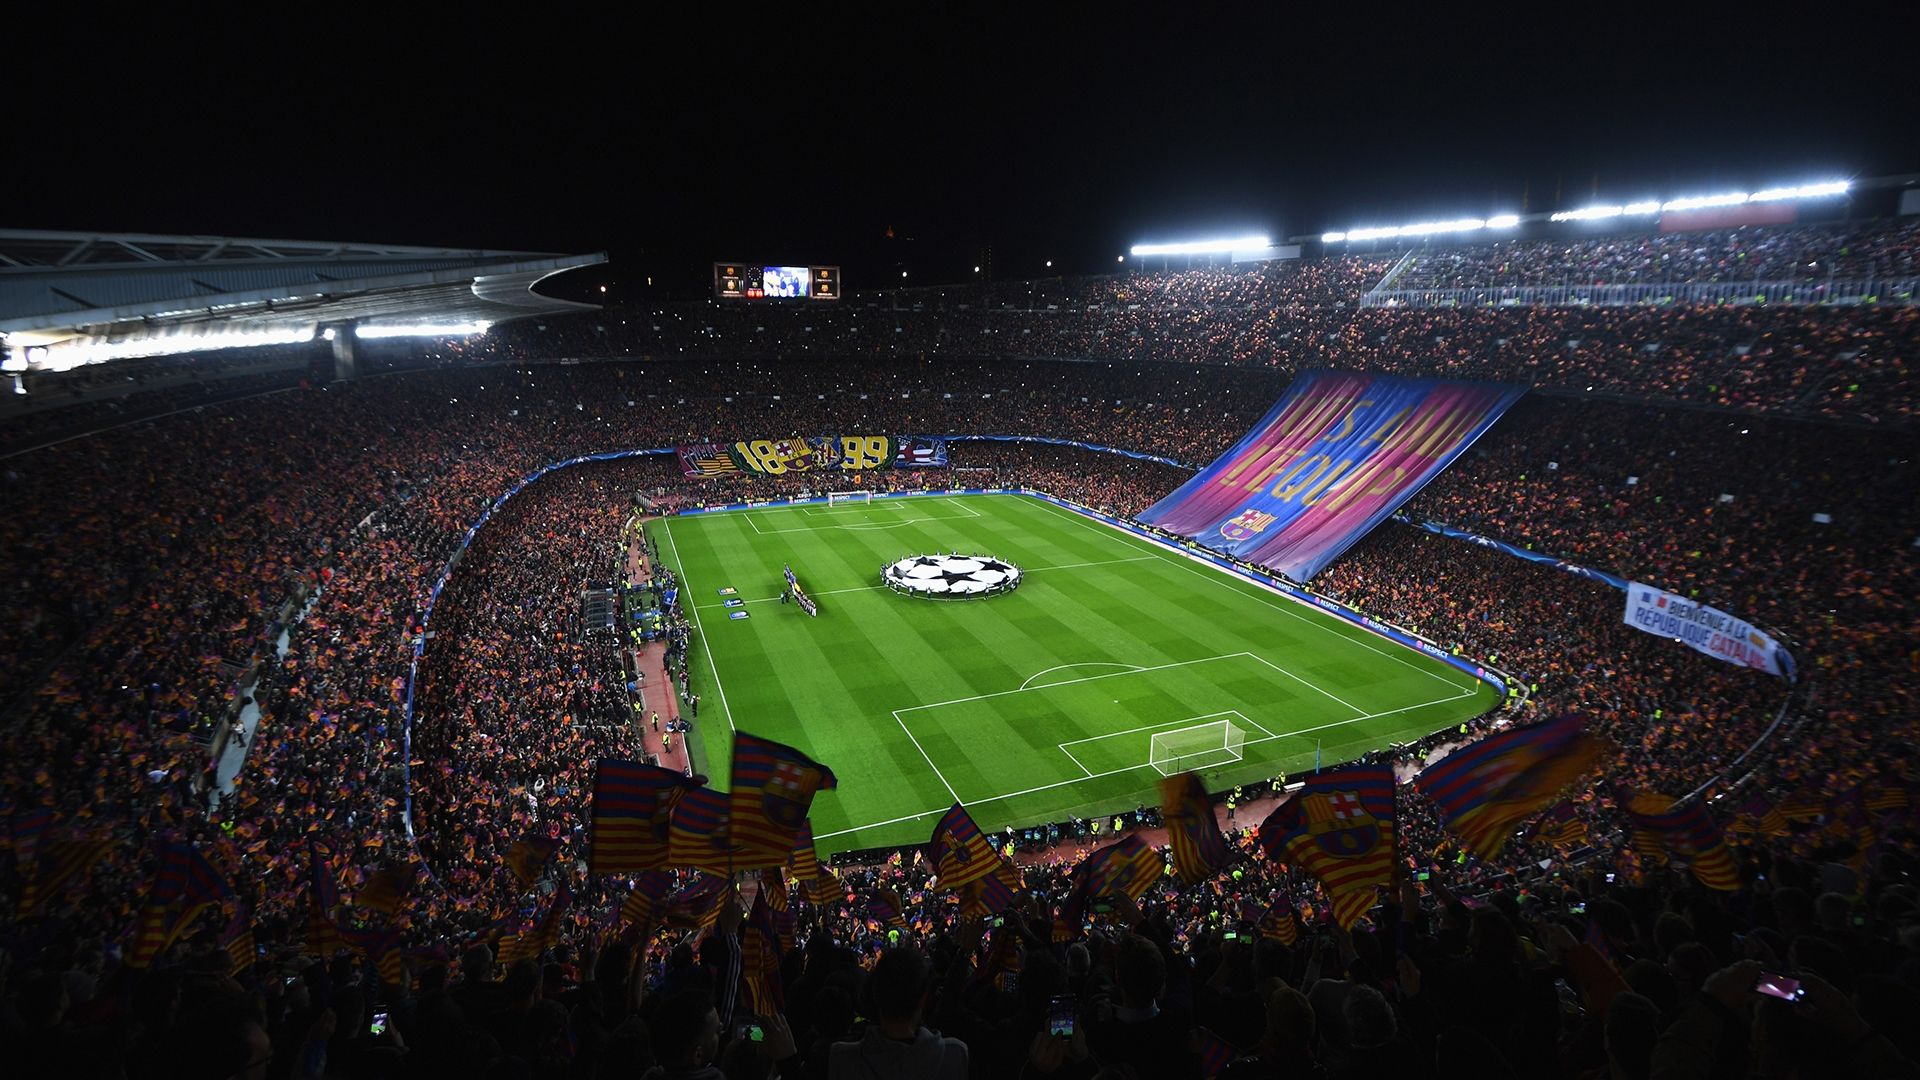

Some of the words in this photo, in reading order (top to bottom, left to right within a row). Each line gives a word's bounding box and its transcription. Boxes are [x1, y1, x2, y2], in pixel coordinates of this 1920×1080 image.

[840, 436, 888, 470] 99
[1368, 620, 1390, 632] RESPECT
[1635, 607, 1711, 646] RÉPUBLIQUE
[1668, 601, 1726, 631] BIENVENUE
[1424, 645, 1449, 657] RESPECT
